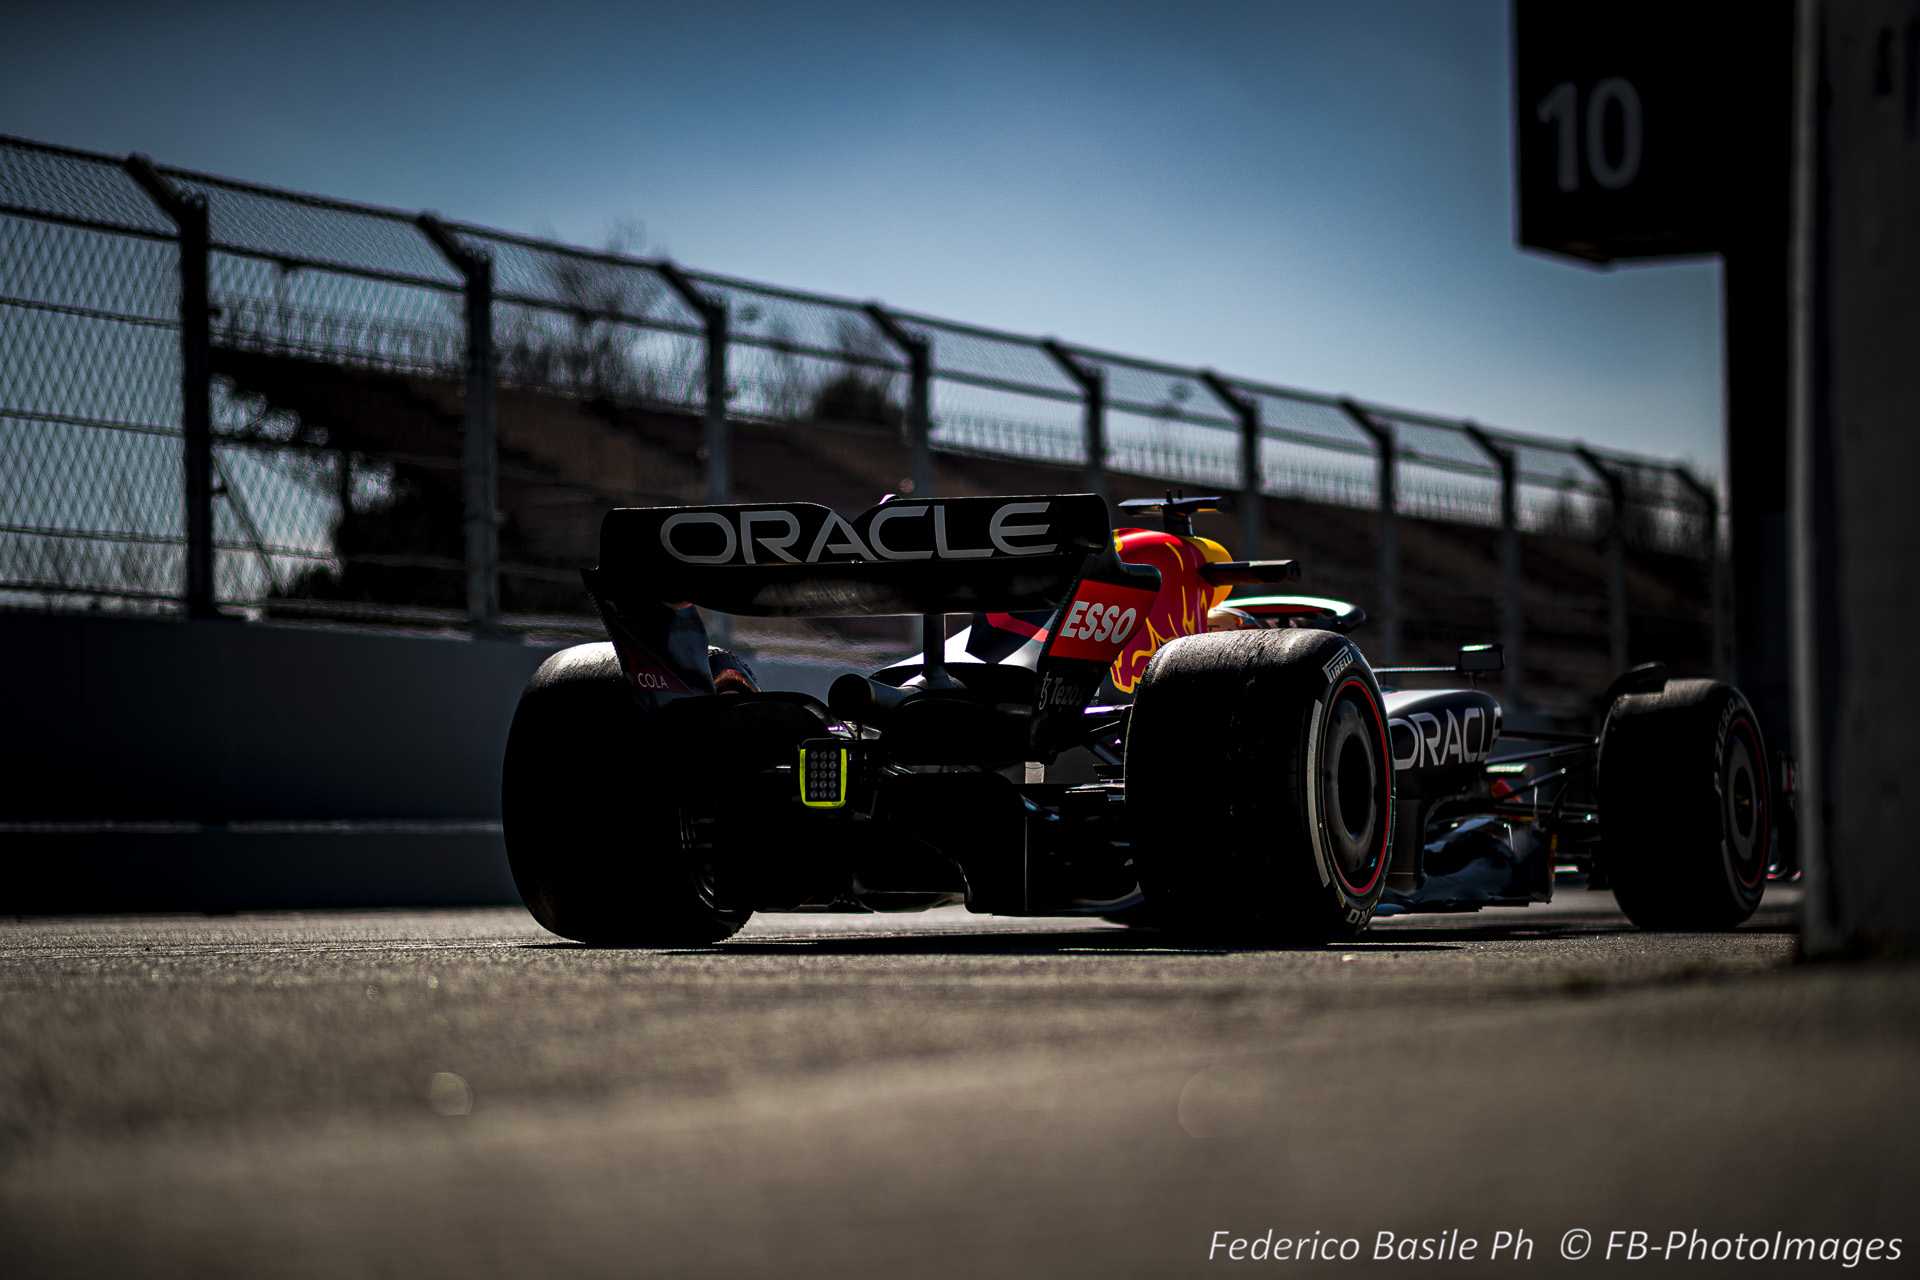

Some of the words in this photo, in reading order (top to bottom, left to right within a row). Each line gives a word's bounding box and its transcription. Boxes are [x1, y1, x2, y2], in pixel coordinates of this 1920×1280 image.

[1536, 75, 1645, 193] 10
[660, 501, 1058, 564] ORACLE
[1060, 600, 1137, 644] ESSO
[638, 673, 669, 689] COLA
[1322, 645, 1354, 684] PIRELLI
